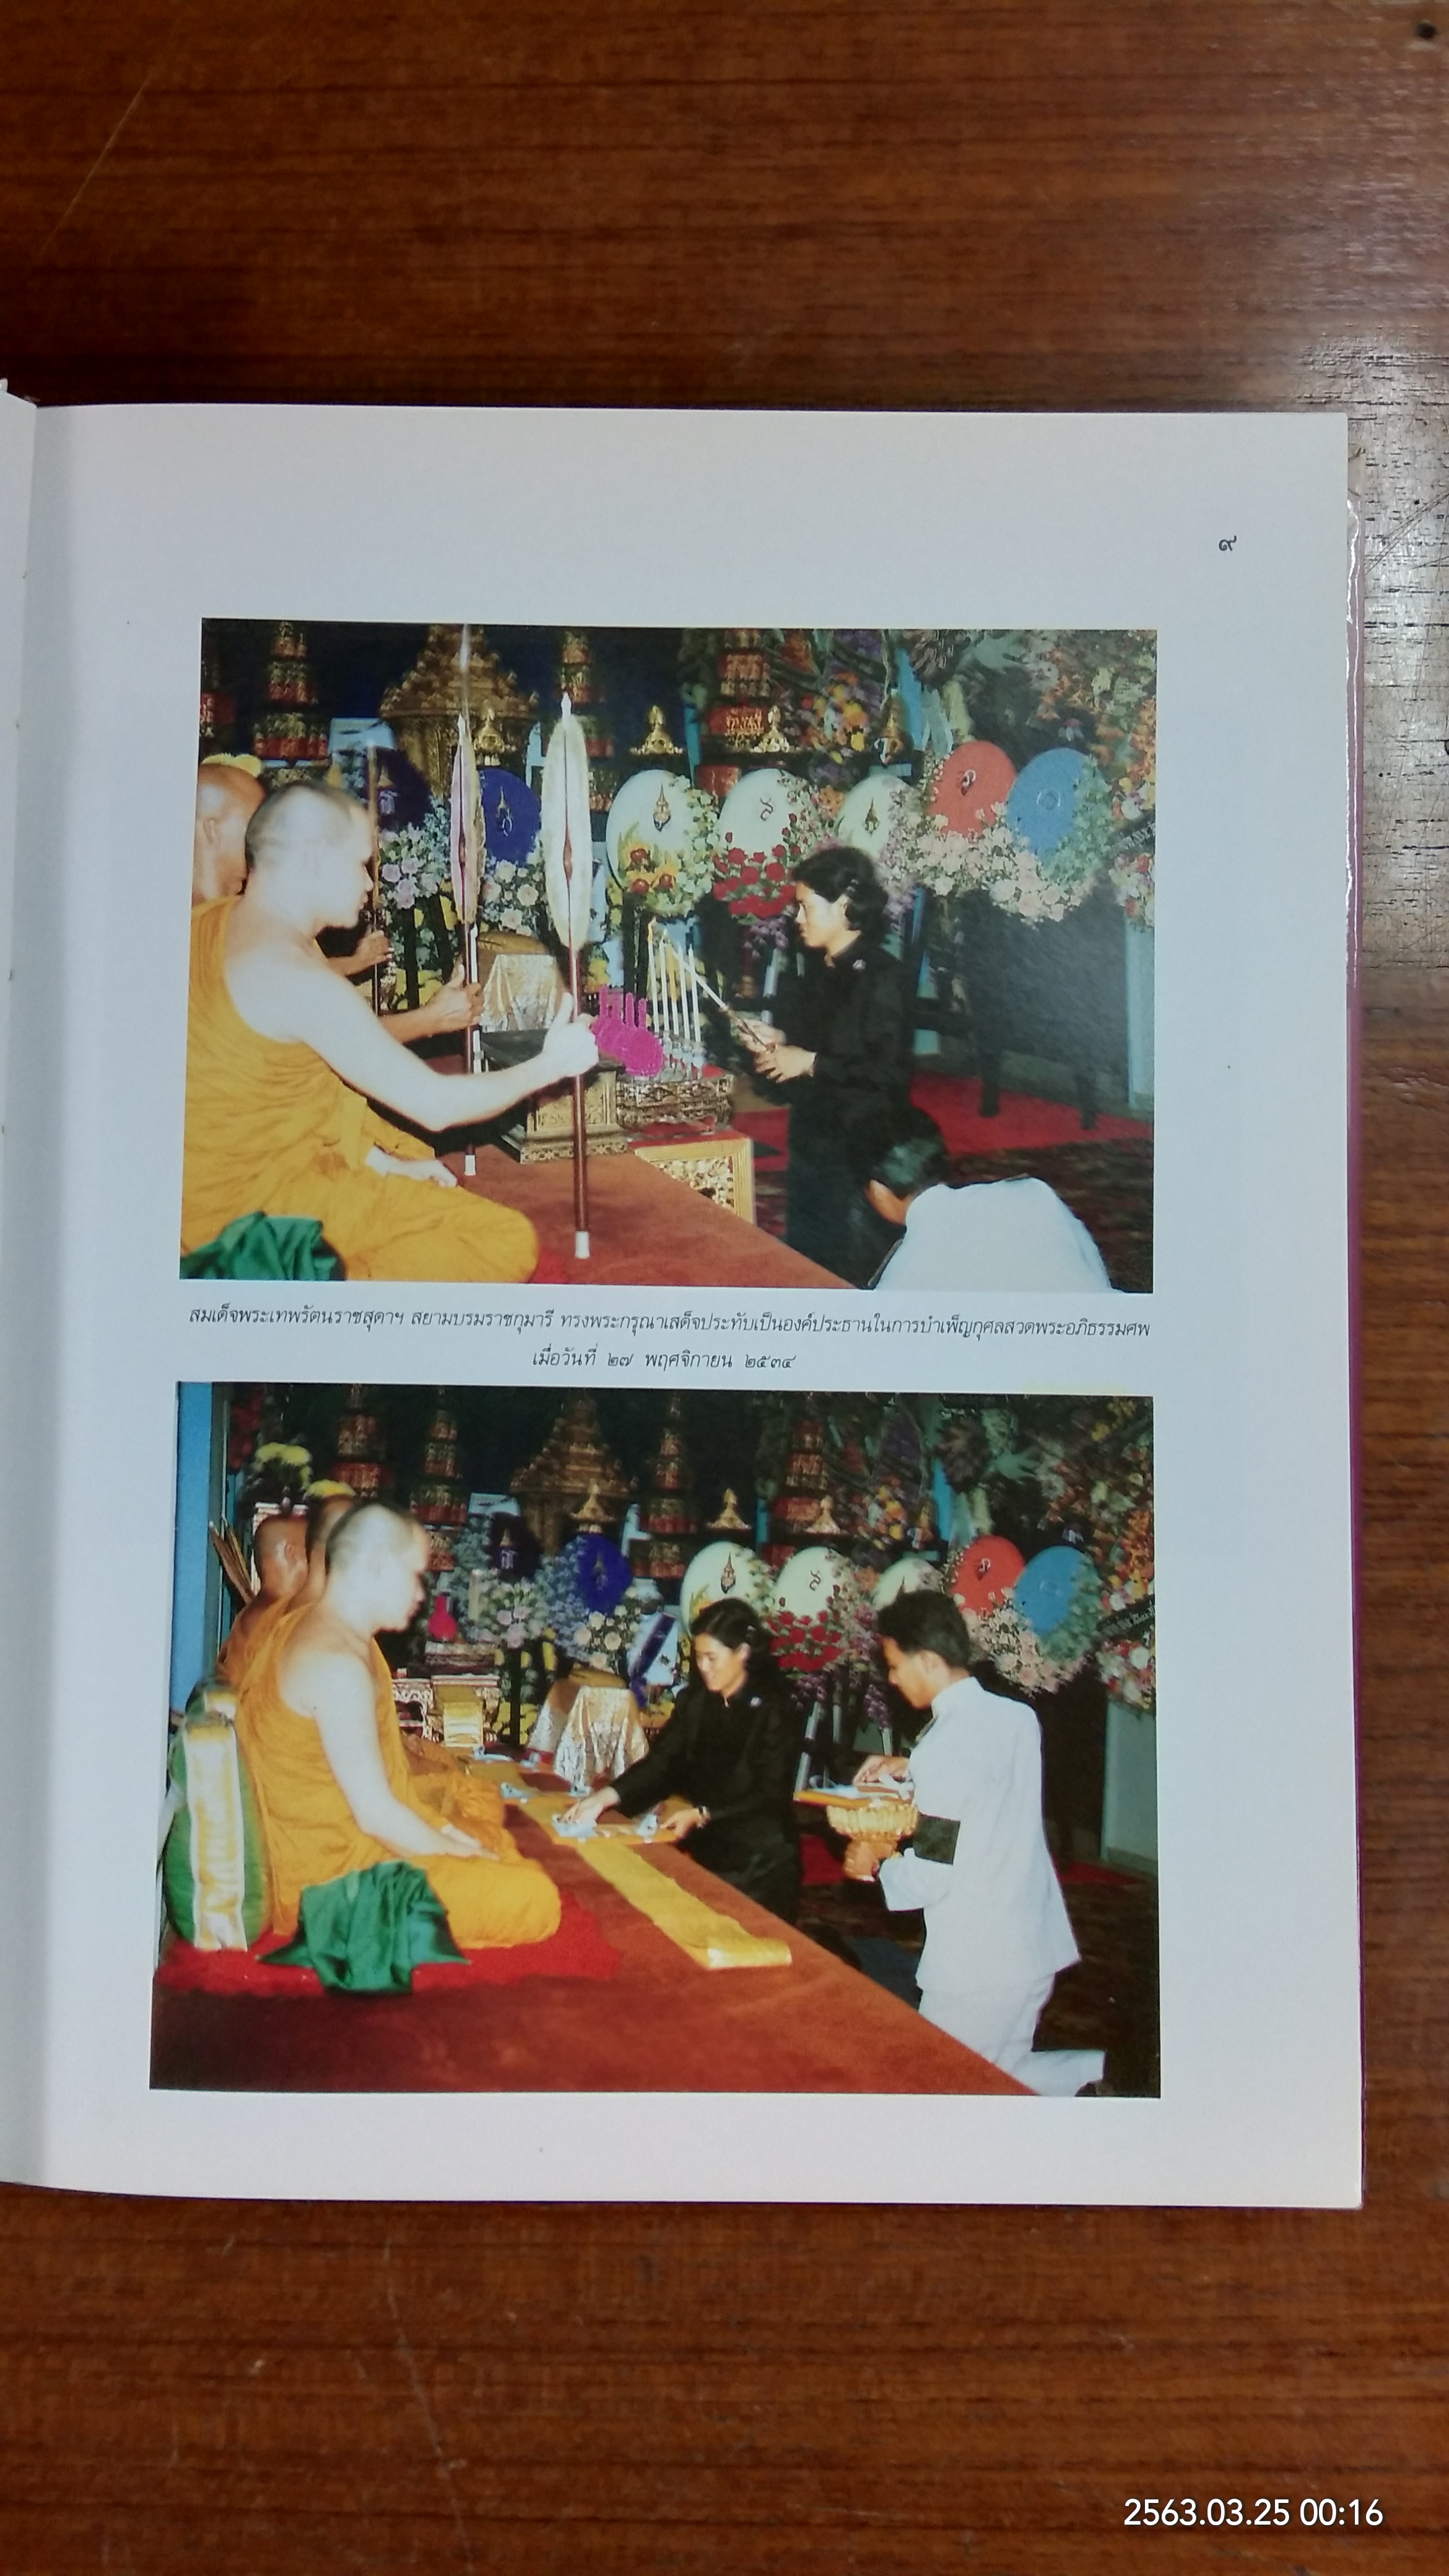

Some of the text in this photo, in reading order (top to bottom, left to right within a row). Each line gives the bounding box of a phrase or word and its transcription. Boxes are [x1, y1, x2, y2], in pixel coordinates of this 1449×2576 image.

[1218, 535, 1237, 552] ๙
[189, 1302, 405, 1333] สมเด็จพระเทพรัตนราชสุดาฯ
[411, 1308, 555, 1334] สยามบรมราชกุมารี
[533, 1342, 796, 1372] เมื่อวันที่ ๒๗ พฤศจิกายน ๒๕๓๔
